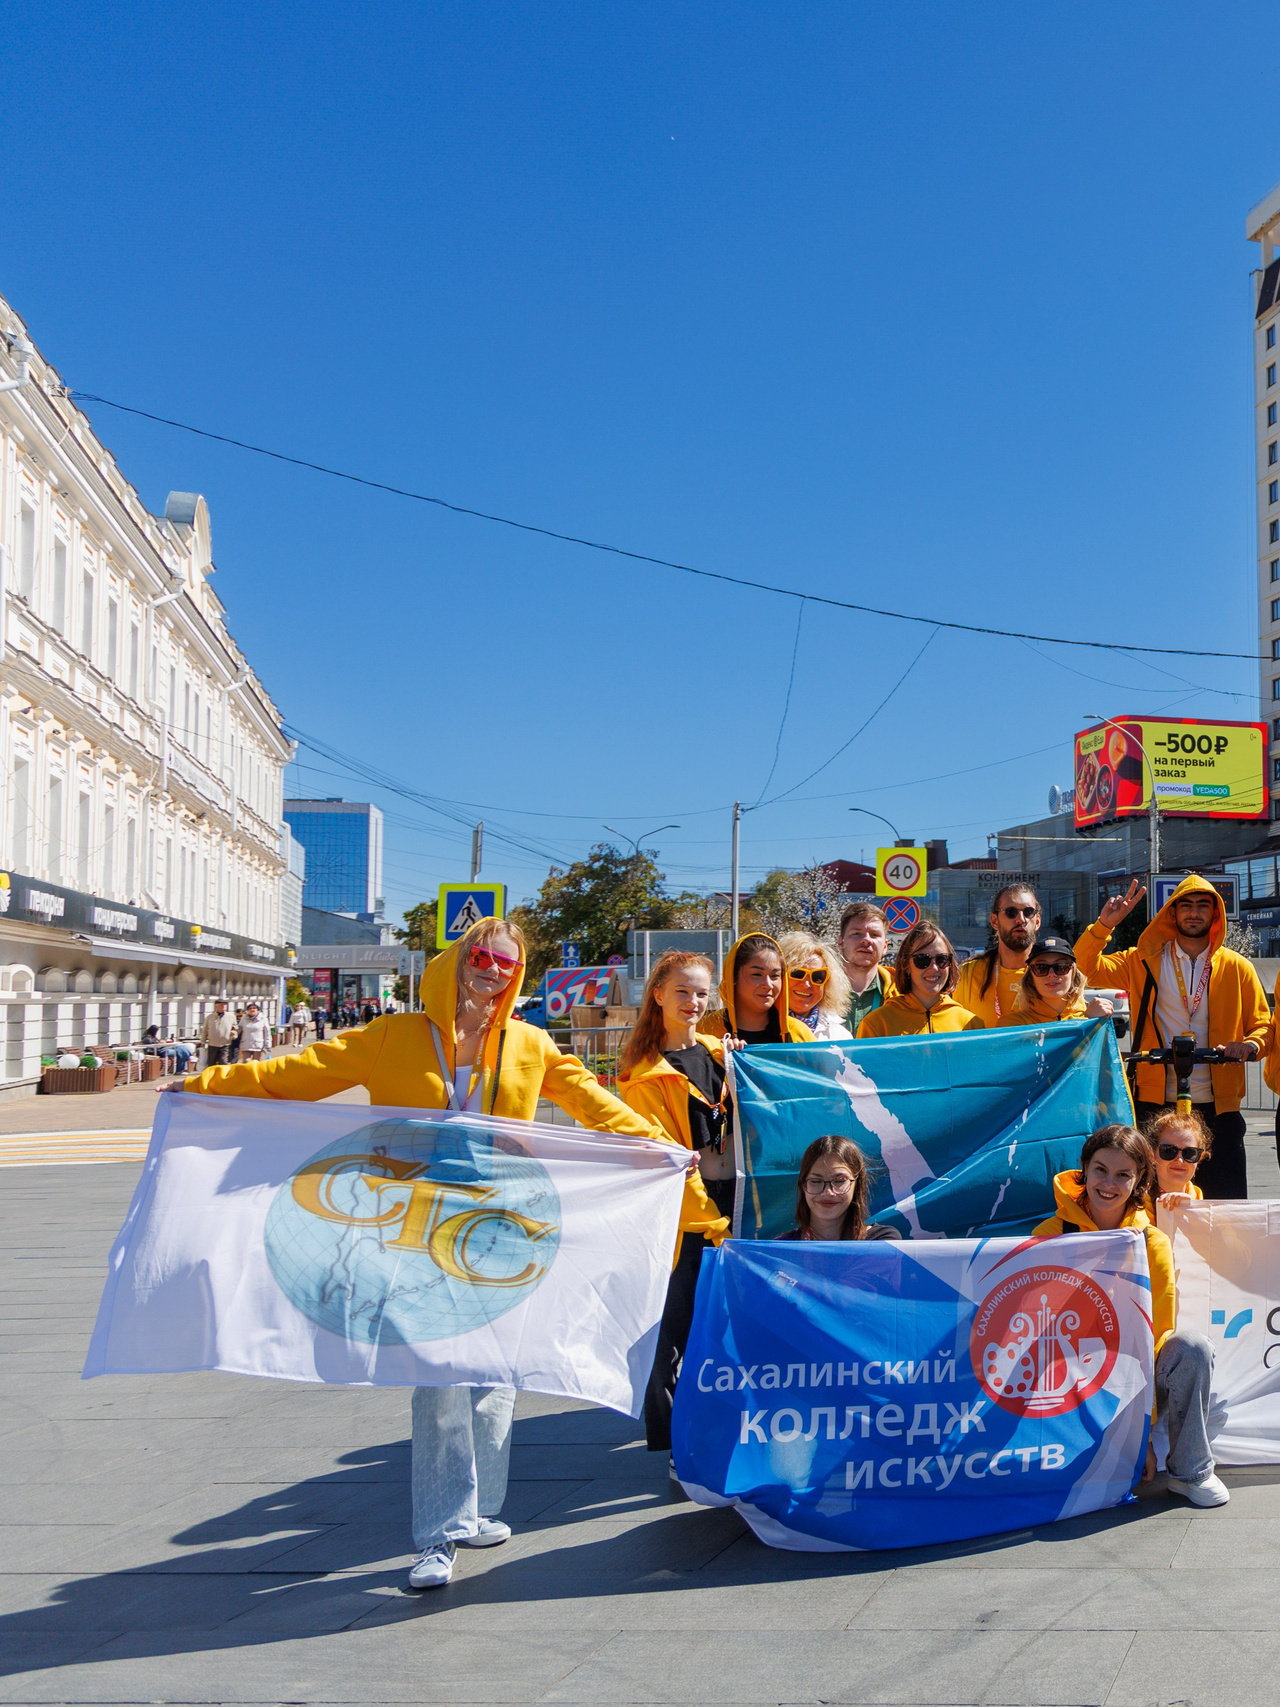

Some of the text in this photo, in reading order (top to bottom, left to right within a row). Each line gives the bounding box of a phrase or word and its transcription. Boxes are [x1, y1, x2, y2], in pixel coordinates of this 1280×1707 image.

[1154, 756, 1215, 769] на первый
[1154, 769, 1187, 778] заказ
[1156, 785, 1228, 795] промокод YEDA500
[889, 865, 913, 880] 40
[977, 872, 1041, 883] КОНТИНЕНТ
[1246, 910, 1273, 921] СЕМЕЙНАЯ
[297, 952, 348, 961] NLIGHT
[290, 1154, 560, 1289] СТС
[976, 1271, 1114, 1337] САХАЛИНСКИЙ КОЛЛЕДЖ ИСКУССТВ
[697, 1350, 956, 1393] Сахалинский
[739, 1400, 987, 1446] колледж
[845, 1442, 1065, 1492] искусств
